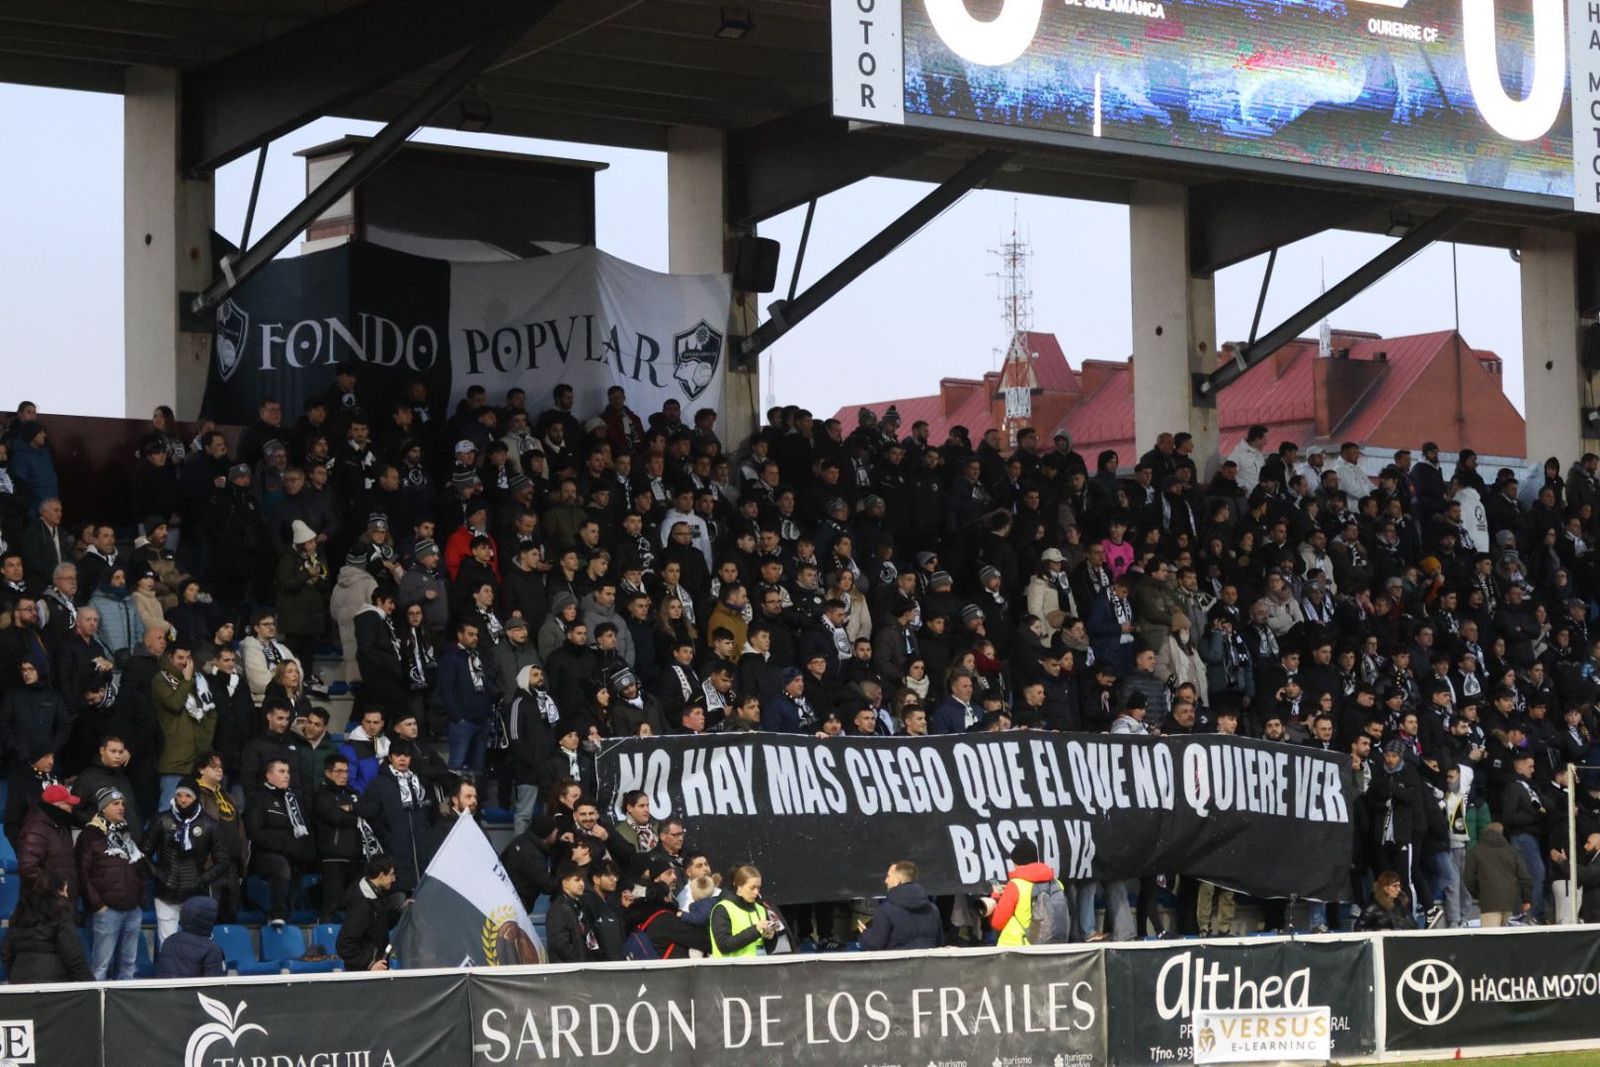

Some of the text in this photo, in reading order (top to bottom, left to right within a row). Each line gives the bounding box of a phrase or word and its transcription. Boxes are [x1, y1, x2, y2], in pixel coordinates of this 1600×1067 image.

[1368, 19, 1438, 42] OURENSE CF
[259, 311, 438, 370] FONDO
[613, 739, 1349, 823] NO HAY MAS CIEGO QUE EL QUE NO QUIERE VER
[1065, 819, 1096, 879] YA
[1156, 951, 1310, 1020] althea
[1542, 973, 1600, 998] MOTO
[482, 981, 1096, 1063] SARDÓN DE LOS FRAILES
[1220, 1016, 1328, 1039] VERSUS
[1231, 1040, 1316, 1052] E-LEARNING
